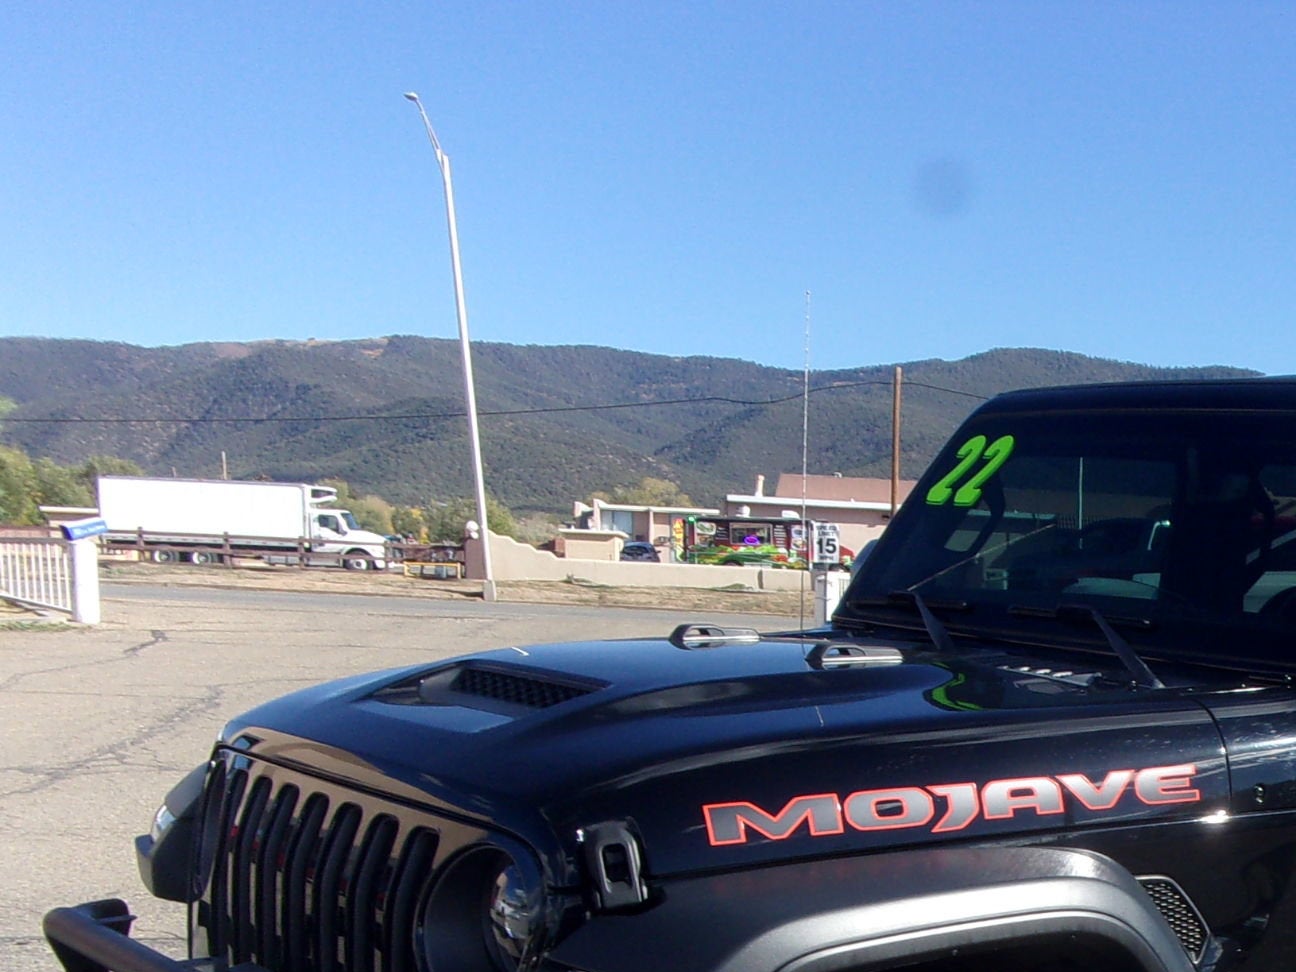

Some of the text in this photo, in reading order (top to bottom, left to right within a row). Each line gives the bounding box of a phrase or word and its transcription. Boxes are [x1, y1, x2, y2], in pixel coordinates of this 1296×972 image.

[925, 435, 1014, 506] 22
[817, 538, 837, 554] 15
[702, 764, 1201, 846] MOJAVE
